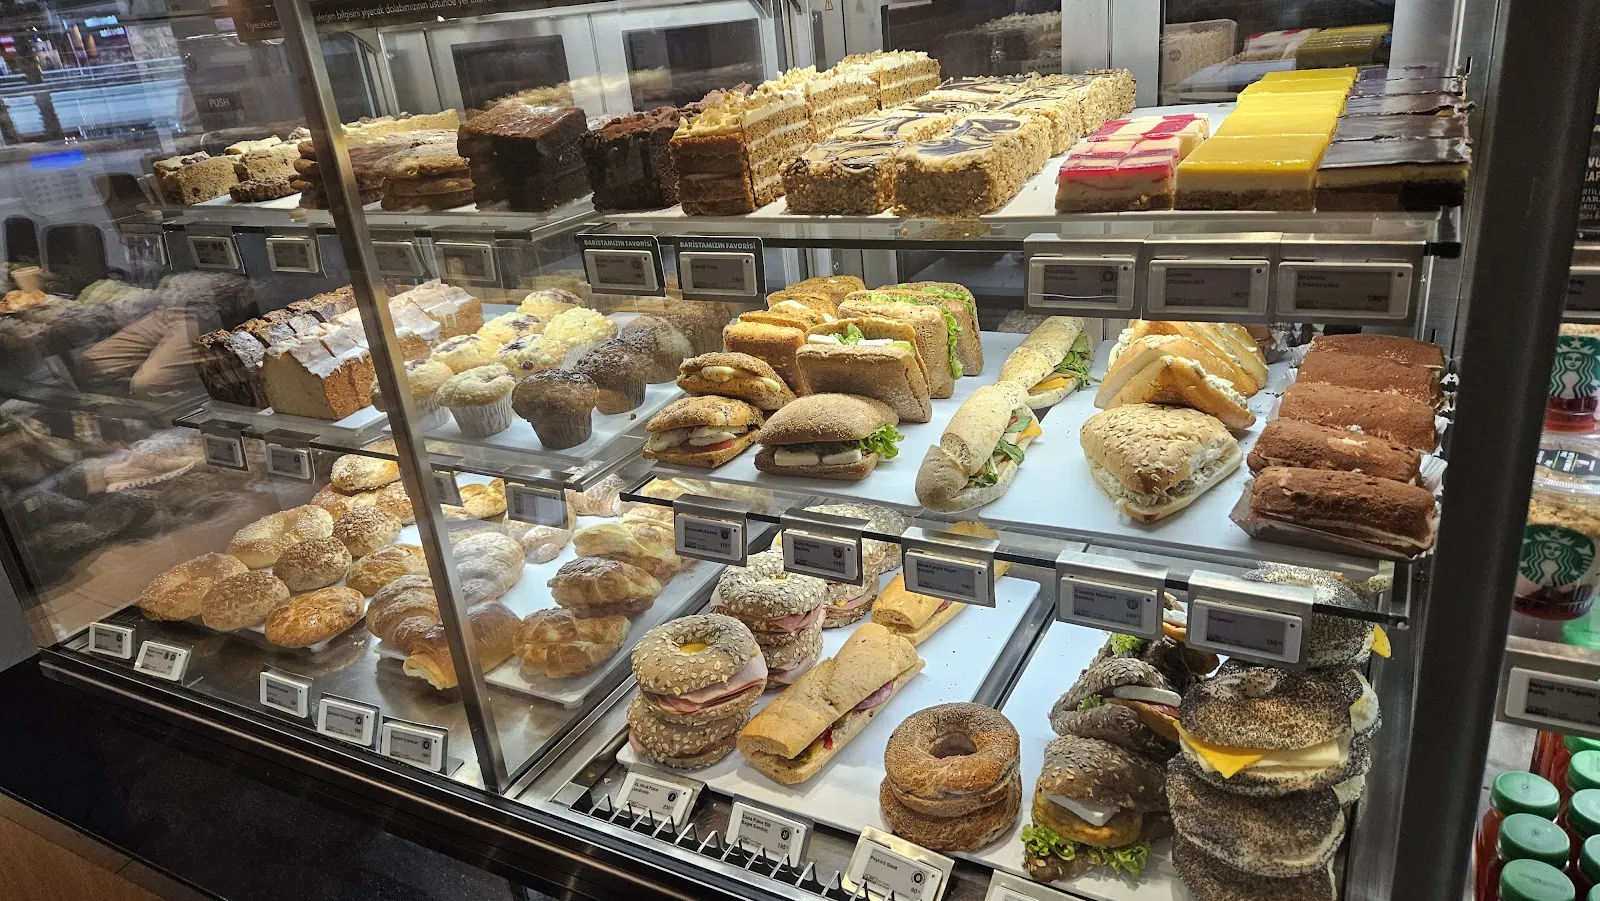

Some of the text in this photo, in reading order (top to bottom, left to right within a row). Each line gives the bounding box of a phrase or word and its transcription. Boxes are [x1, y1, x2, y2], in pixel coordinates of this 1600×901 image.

[336, 8, 360, 21] bilgisini
[361, 5, 384, 18] yiyecek
[209, 98, 230, 108] PUSH
[584, 239, 625, 247] BARİSTAMIZIN
[680, 241, 756, 249] BARİSTAMIZIN FAVORİSİ
